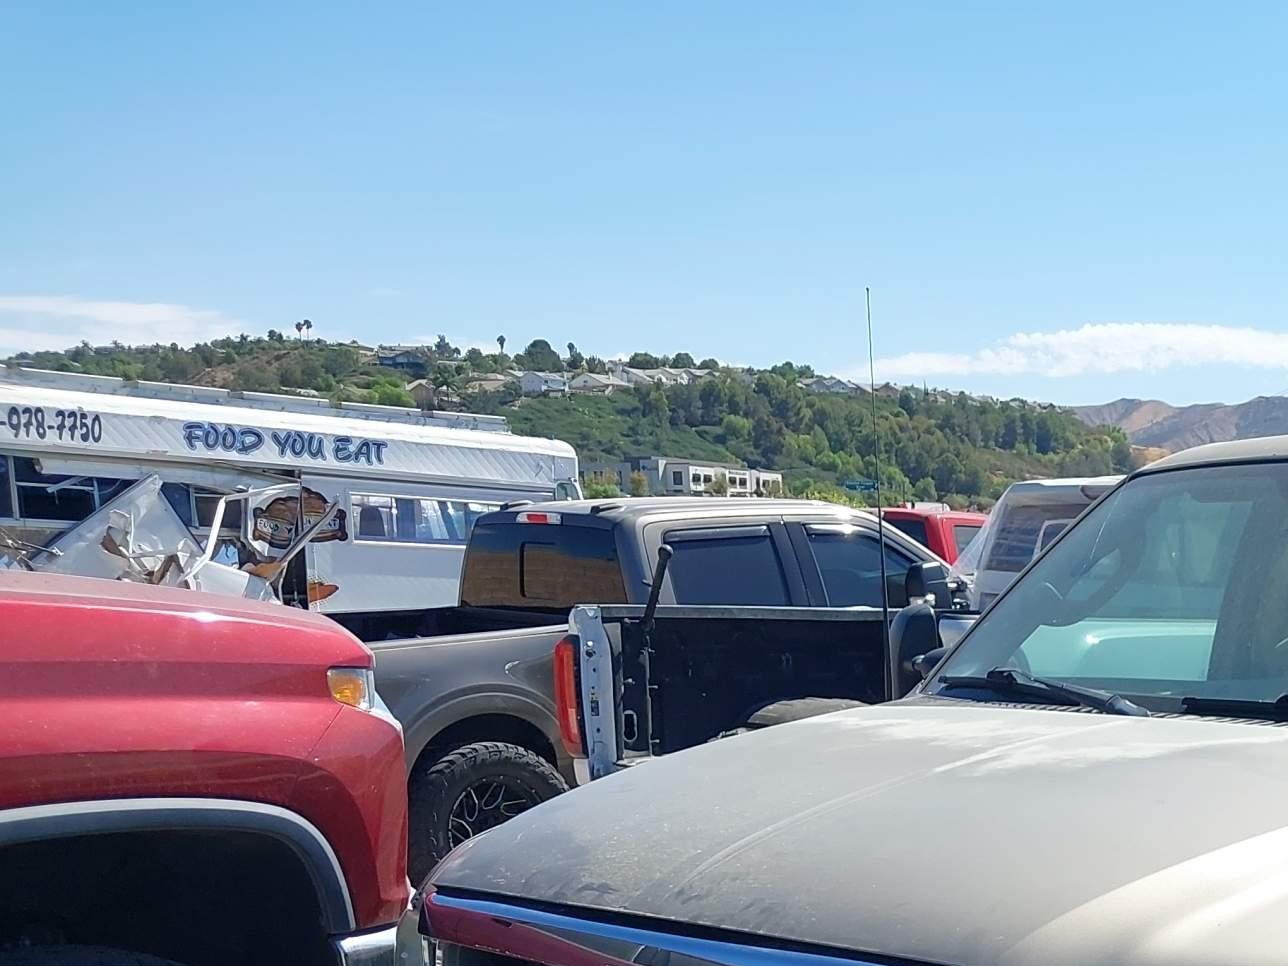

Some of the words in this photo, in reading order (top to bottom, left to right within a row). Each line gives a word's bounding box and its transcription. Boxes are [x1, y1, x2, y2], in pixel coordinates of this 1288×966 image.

[183, 421, 265, 455] FOOD
[271, 430, 327, 461] YOU
[332, 435, 388, 465] EAT
